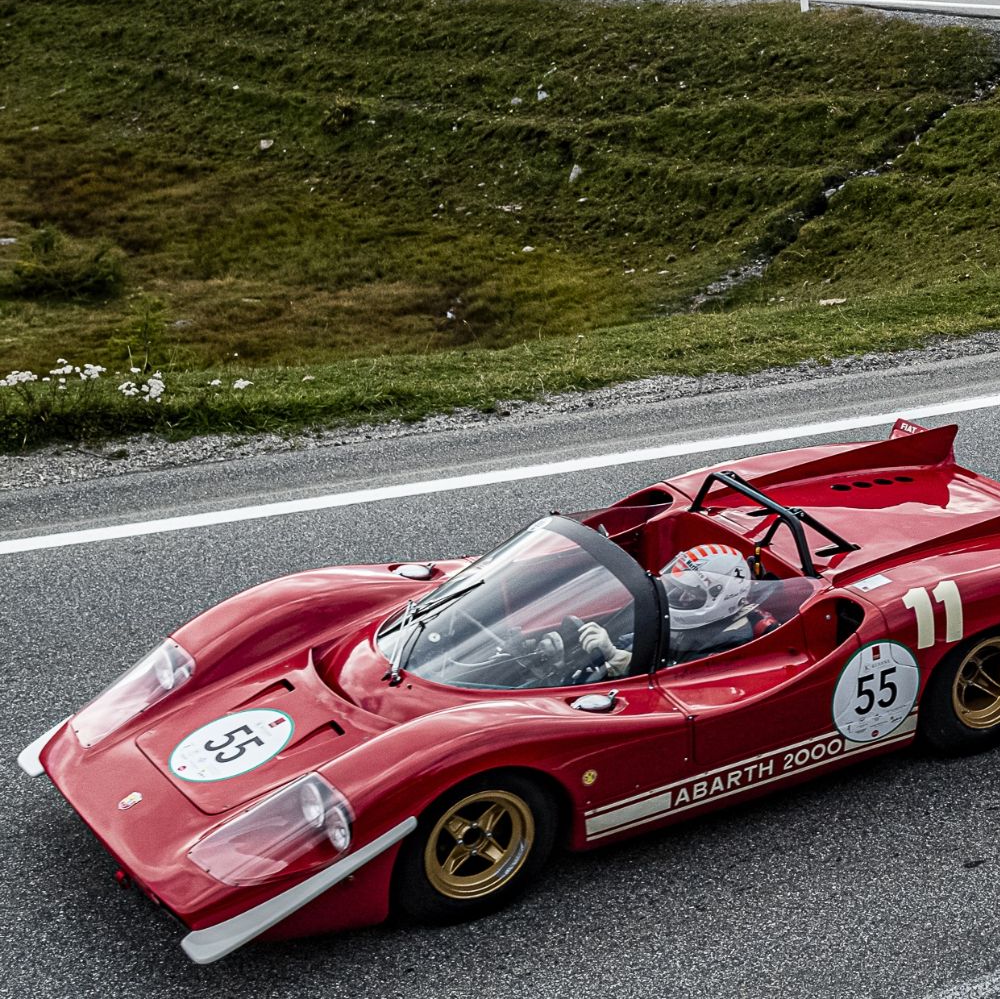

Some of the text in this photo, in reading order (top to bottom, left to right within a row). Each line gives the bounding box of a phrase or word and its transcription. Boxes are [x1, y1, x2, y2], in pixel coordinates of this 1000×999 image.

[900, 422, 918, 434] FIAT
[901, 579, 964, 650] 11
[854, 666, 898, 715] 55
[204, 724, 265, 763] 55
[674, 738, 843, 807] ABARTH 2000
